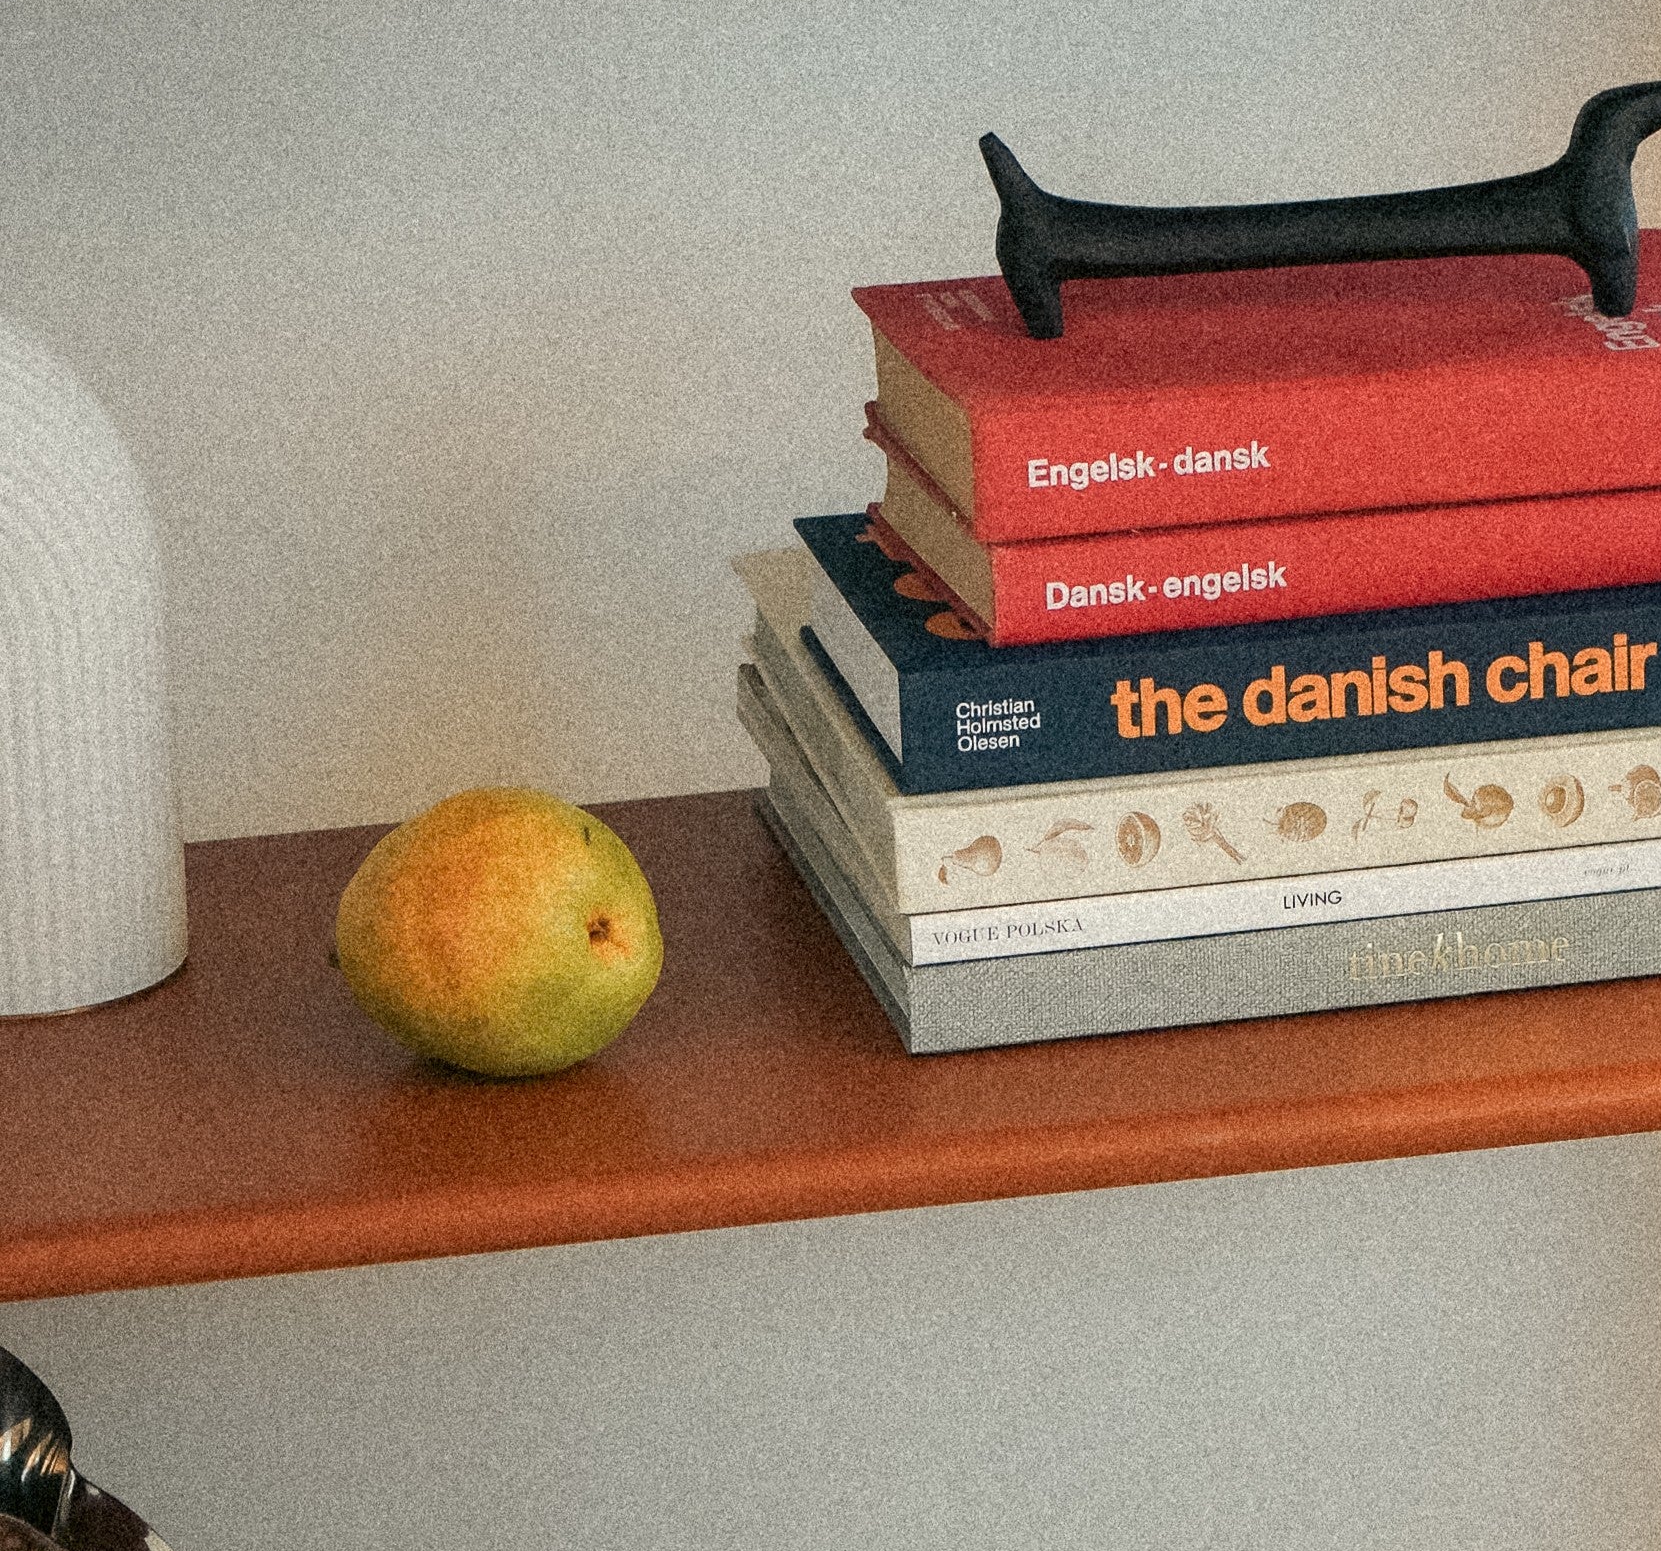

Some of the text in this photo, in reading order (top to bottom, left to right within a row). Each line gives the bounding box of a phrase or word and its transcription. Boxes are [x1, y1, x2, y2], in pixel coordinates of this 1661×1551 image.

[1110, 633, 1658, 739] the danish chair
[955, 697, 1036, 719] Christian
[956, 711, 1041, 736] Holmsted
[957, 734, 1020, 752] Olesen
[1283, 889, 1343, 910] LIVING
[932, 918, 1084, 946] VOGUE POLSKA
